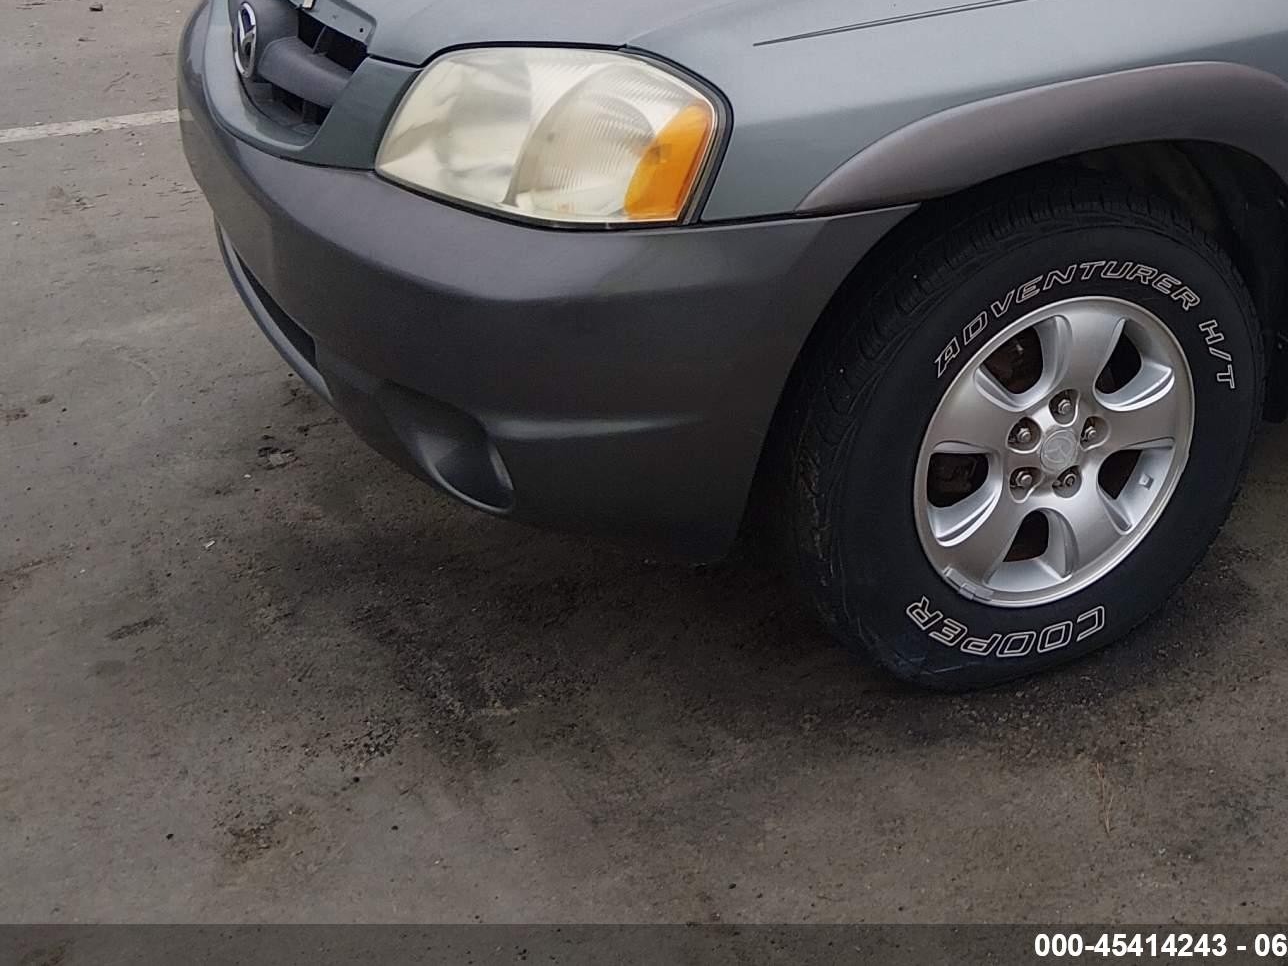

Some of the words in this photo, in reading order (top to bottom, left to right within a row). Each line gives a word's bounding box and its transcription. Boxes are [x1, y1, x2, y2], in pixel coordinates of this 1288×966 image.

[935, 259, 1200, 378] ADVENTURER
[1198, 319, 1236, 390] H/T
[905, 595, 1106, 658] COOPER
